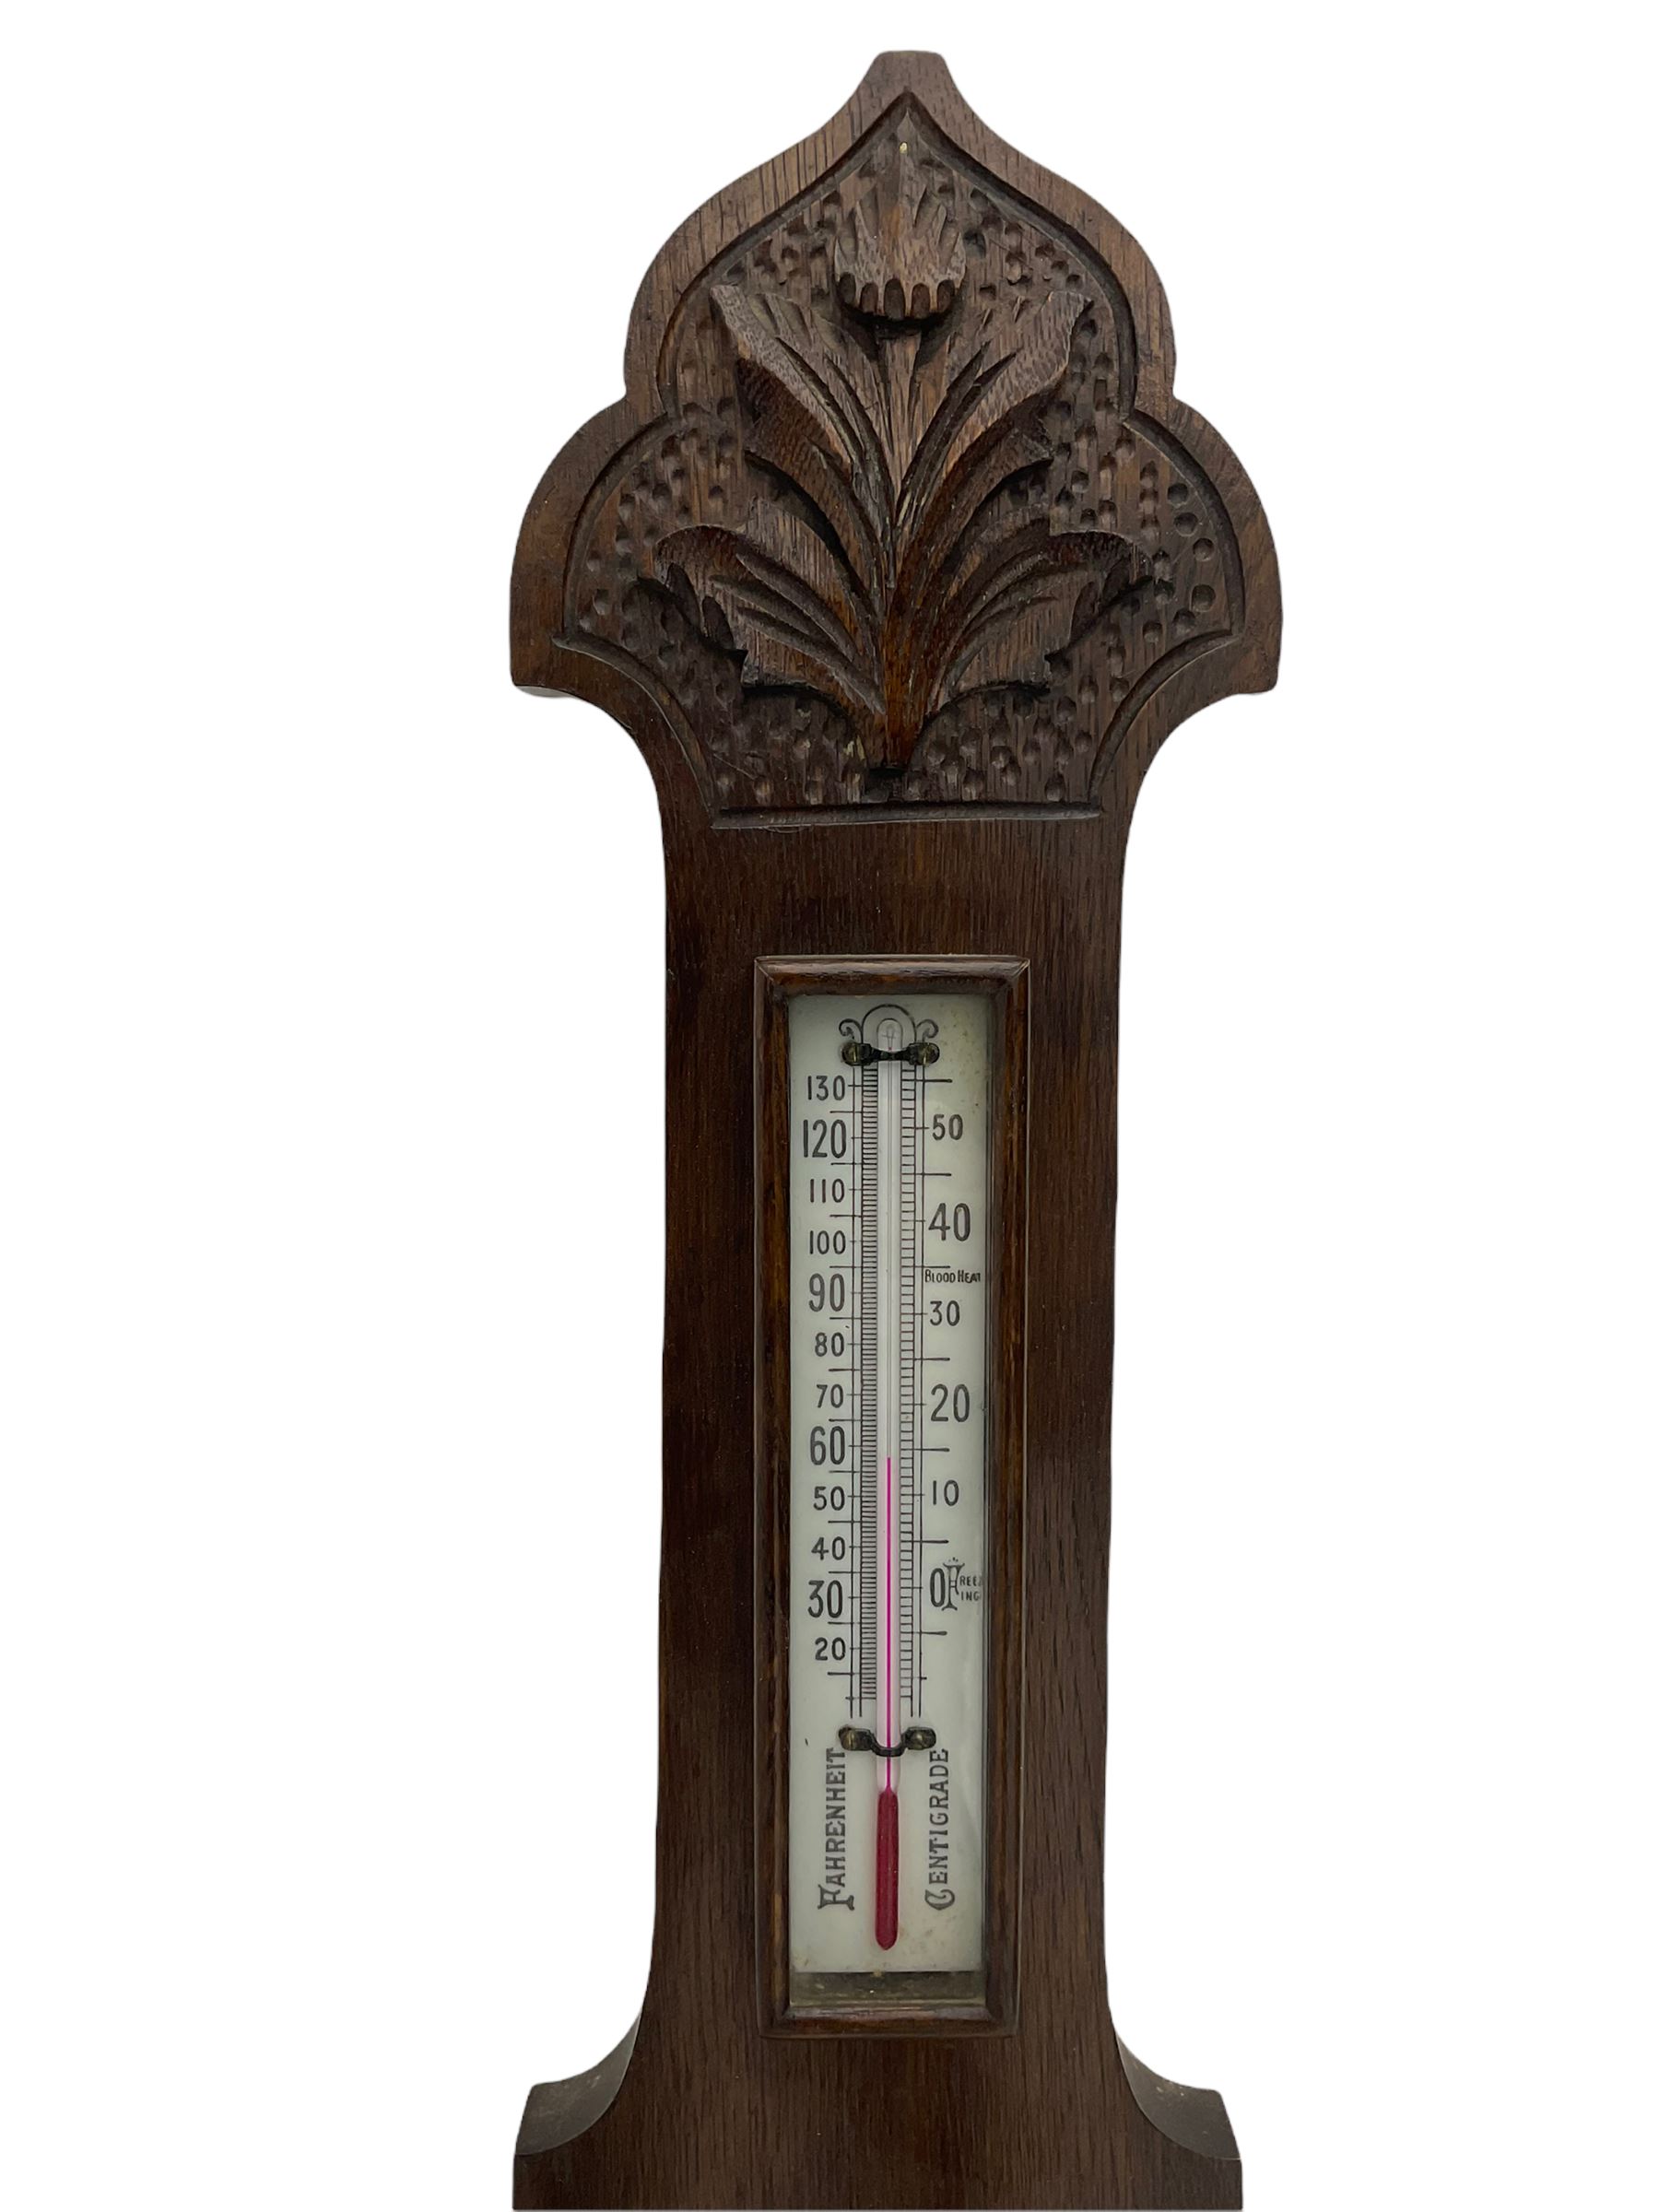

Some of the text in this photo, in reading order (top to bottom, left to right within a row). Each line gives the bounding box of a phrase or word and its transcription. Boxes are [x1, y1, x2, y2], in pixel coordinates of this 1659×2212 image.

[807, 1075, 846, 1100] 130
[803, 1119, 847, 1159] 120
[932, 1113, 963, 1140] 50
[809, 1178, 845, 1203] 110
[928, 1202, 971, 1241] 40
[809, 1230, 846, 1254] 100
[808, 1273, 845, 1312] 90
[930, 1300, 960, 1326] 30
[814, 1332, 845, 1357] 80
[816, 1383, 844, 1408] 70
[930, 1383, 970, 1422] 20
[809, 1426, 845, 1465] 60
[813, 1486, 845, 1511] 50
[932, 1479, 959, 1506] 10
[811, 1536, 846, 1560] 40
[807, 1580, 843, 1618] 30
[929, 1568, 945, 1607] 0
[814, 1637, 846, 1661] 20
[818, 1747, 854, 1911] FAHRENHEIT
[924, 1748, 955, 1911] CENTIGRADE
